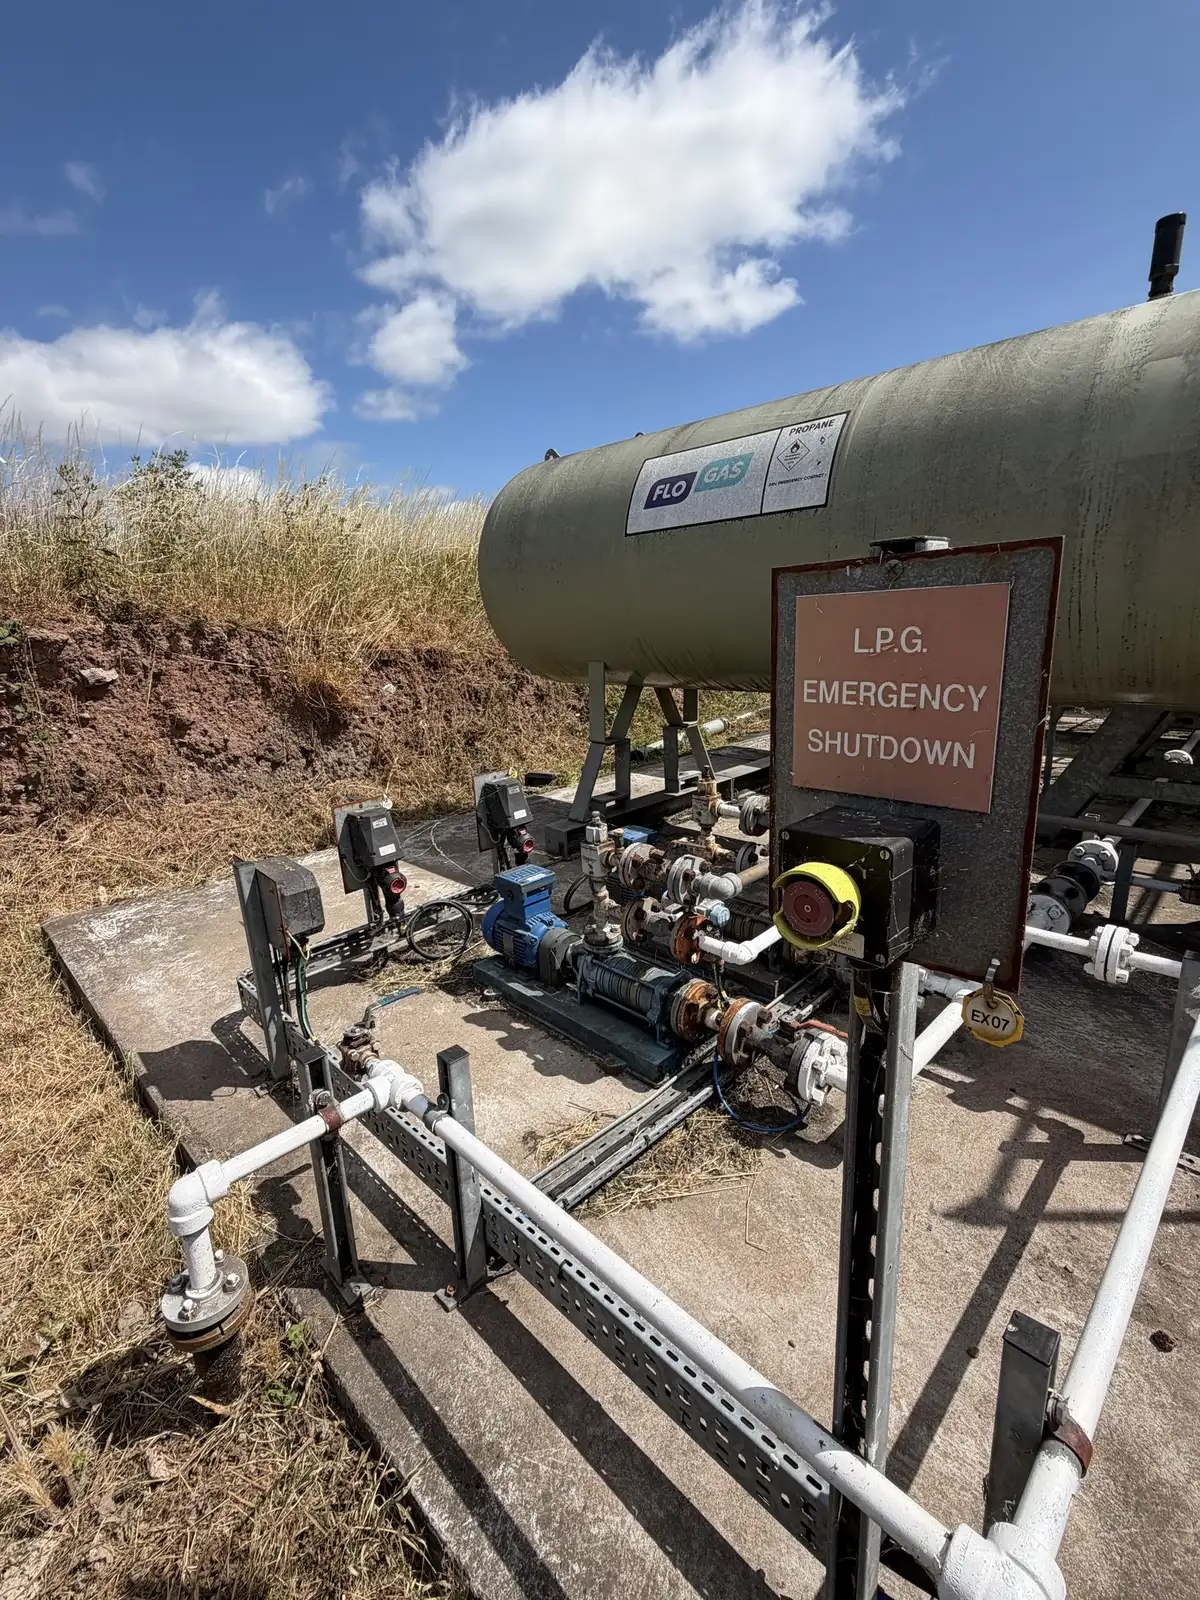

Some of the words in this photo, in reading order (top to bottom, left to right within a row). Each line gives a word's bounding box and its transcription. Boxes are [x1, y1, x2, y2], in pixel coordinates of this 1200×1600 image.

[788, 418, 836, 436] PROPANE
[703, 460, 745, 484] GAS
[651, 480, 688, 502] FLO
[853, 625, 928, 654] L.P.G.
[803, 680, 988, 712] EMERGENCY
[807, 728, 976, 769] SHUTDOWN
